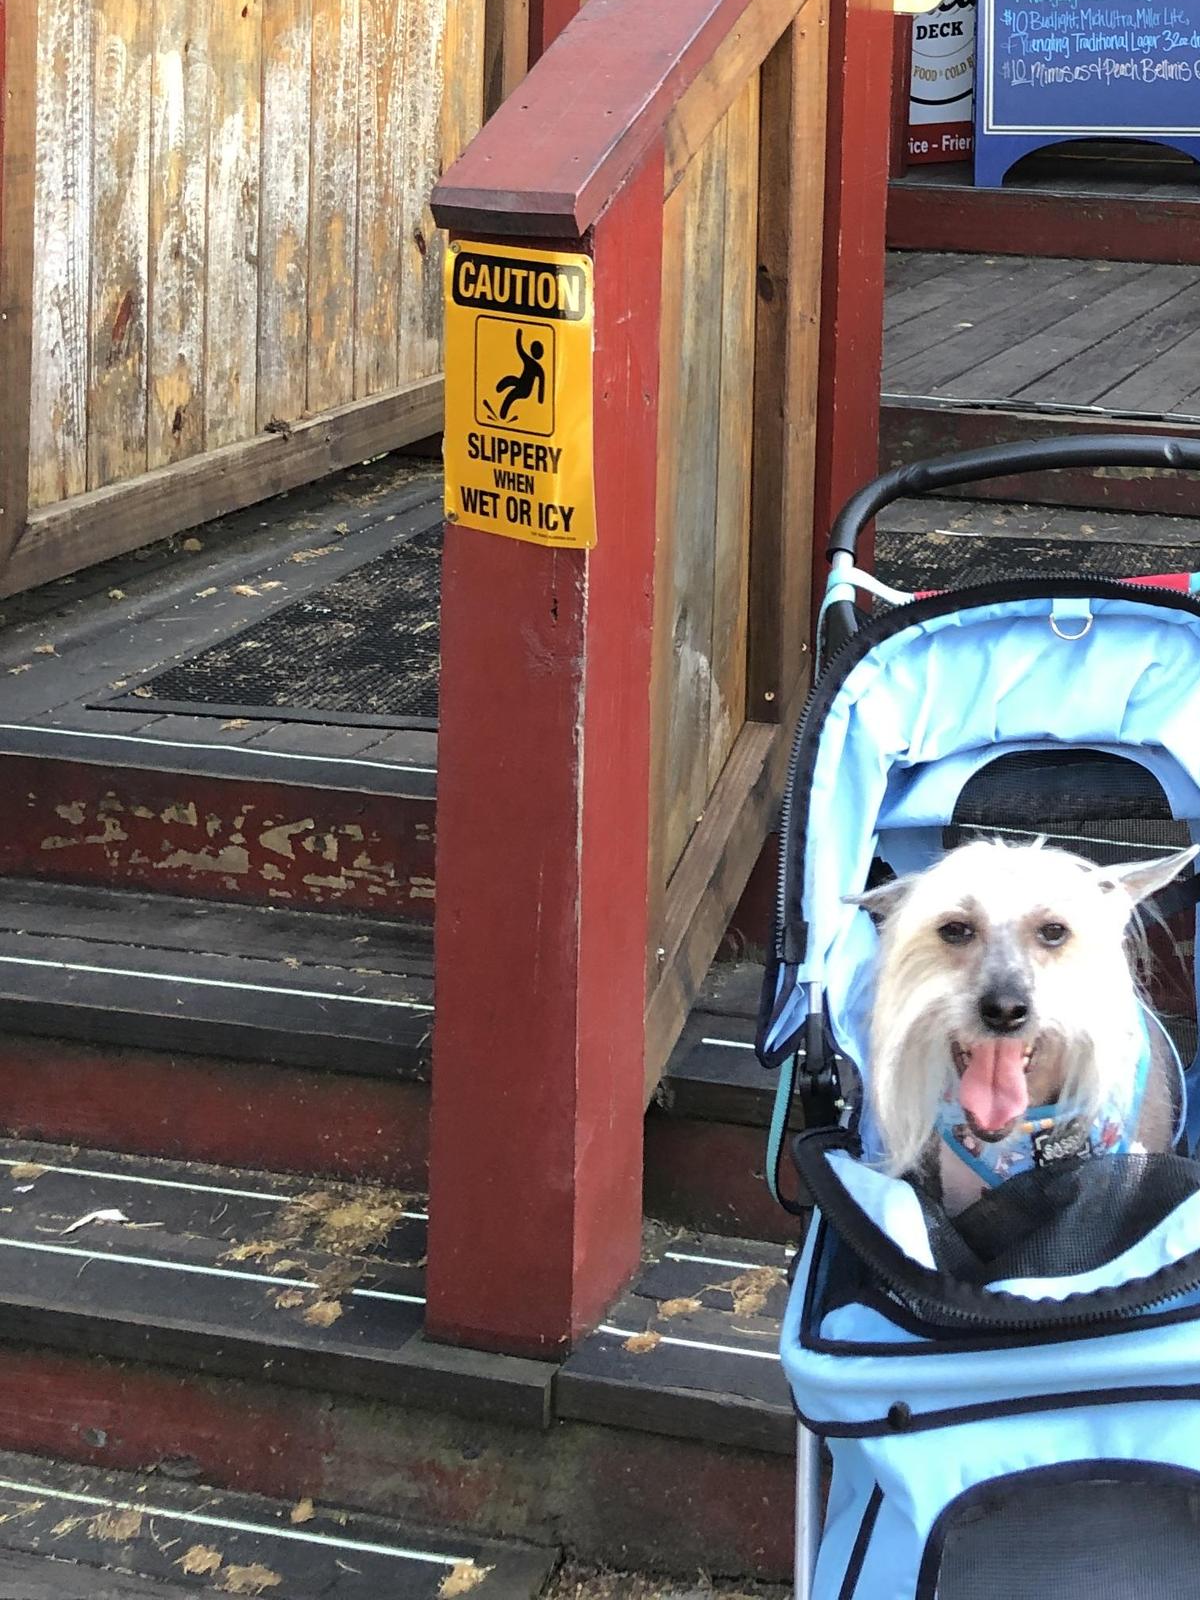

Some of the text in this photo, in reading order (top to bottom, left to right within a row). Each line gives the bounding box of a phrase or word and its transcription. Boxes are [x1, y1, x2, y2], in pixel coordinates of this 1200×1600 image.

[916, 21, 964, 40] DECK
[1019, 32, 1070, 60] Yuengling
[1070, 31, 1128, 54] Traditional
[1130, 32, 1160, 55] Lager
[913, 65, 938, 82] FOOD
[945, 60, 967, 81] COLD
[1104, 58, 1142, 87] Peach
[458, 261, 580, 312] CAUTION
[467, 432, 562, 474] SLIPPERY
[493, 468, 534, 495] WHEN
[460, 486, 575, 533] WET OR ICY
